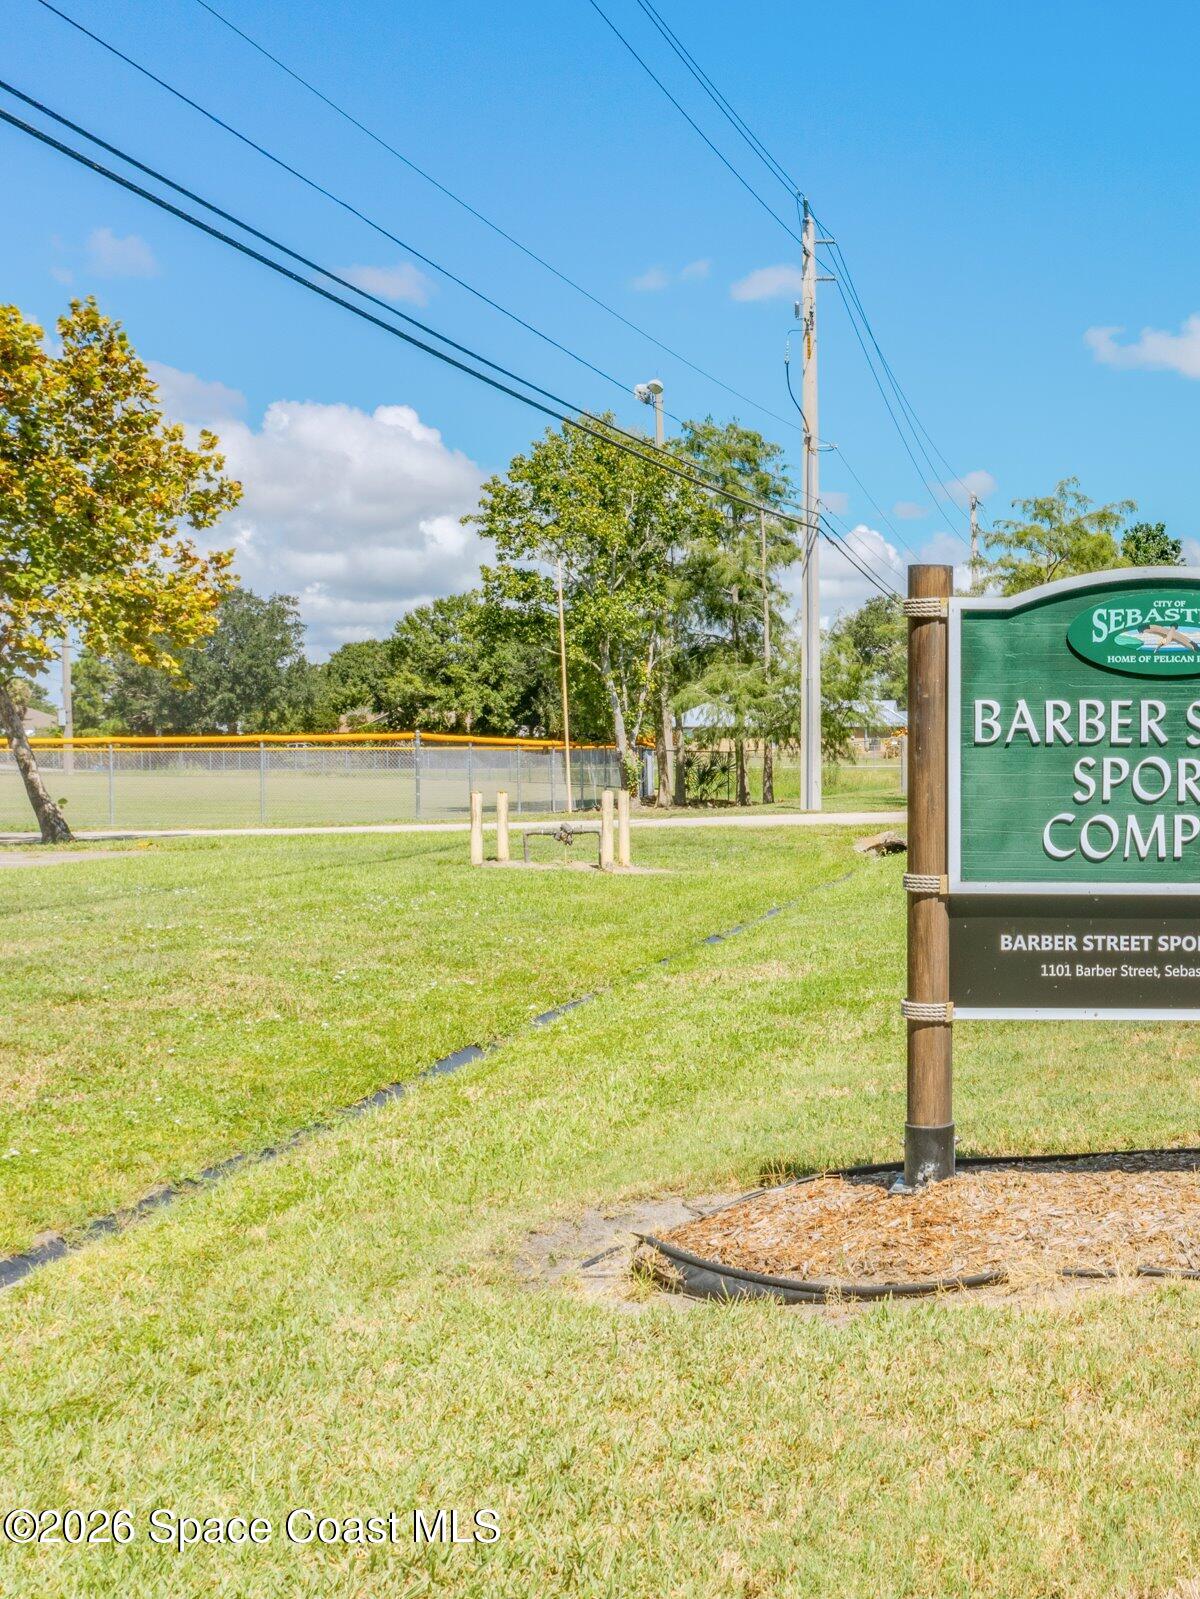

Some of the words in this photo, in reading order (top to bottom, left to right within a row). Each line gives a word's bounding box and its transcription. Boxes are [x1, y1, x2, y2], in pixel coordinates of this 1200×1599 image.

[1107, 655, 1136, 663] HOME
[1139, 655, 1152, 663] OF
[1154, 655, 1195, 663] PELICAN
[973, 699, 1169, 747] BARBER
[1000, 934, 1077, 951] BARBER
[1082, 935, 1152, 951] STREET
[1041, 964, 1071, 977] 1101
[1076, 964, 1117, 977] Barber
[1121, 964, 1161, 980] Street,
